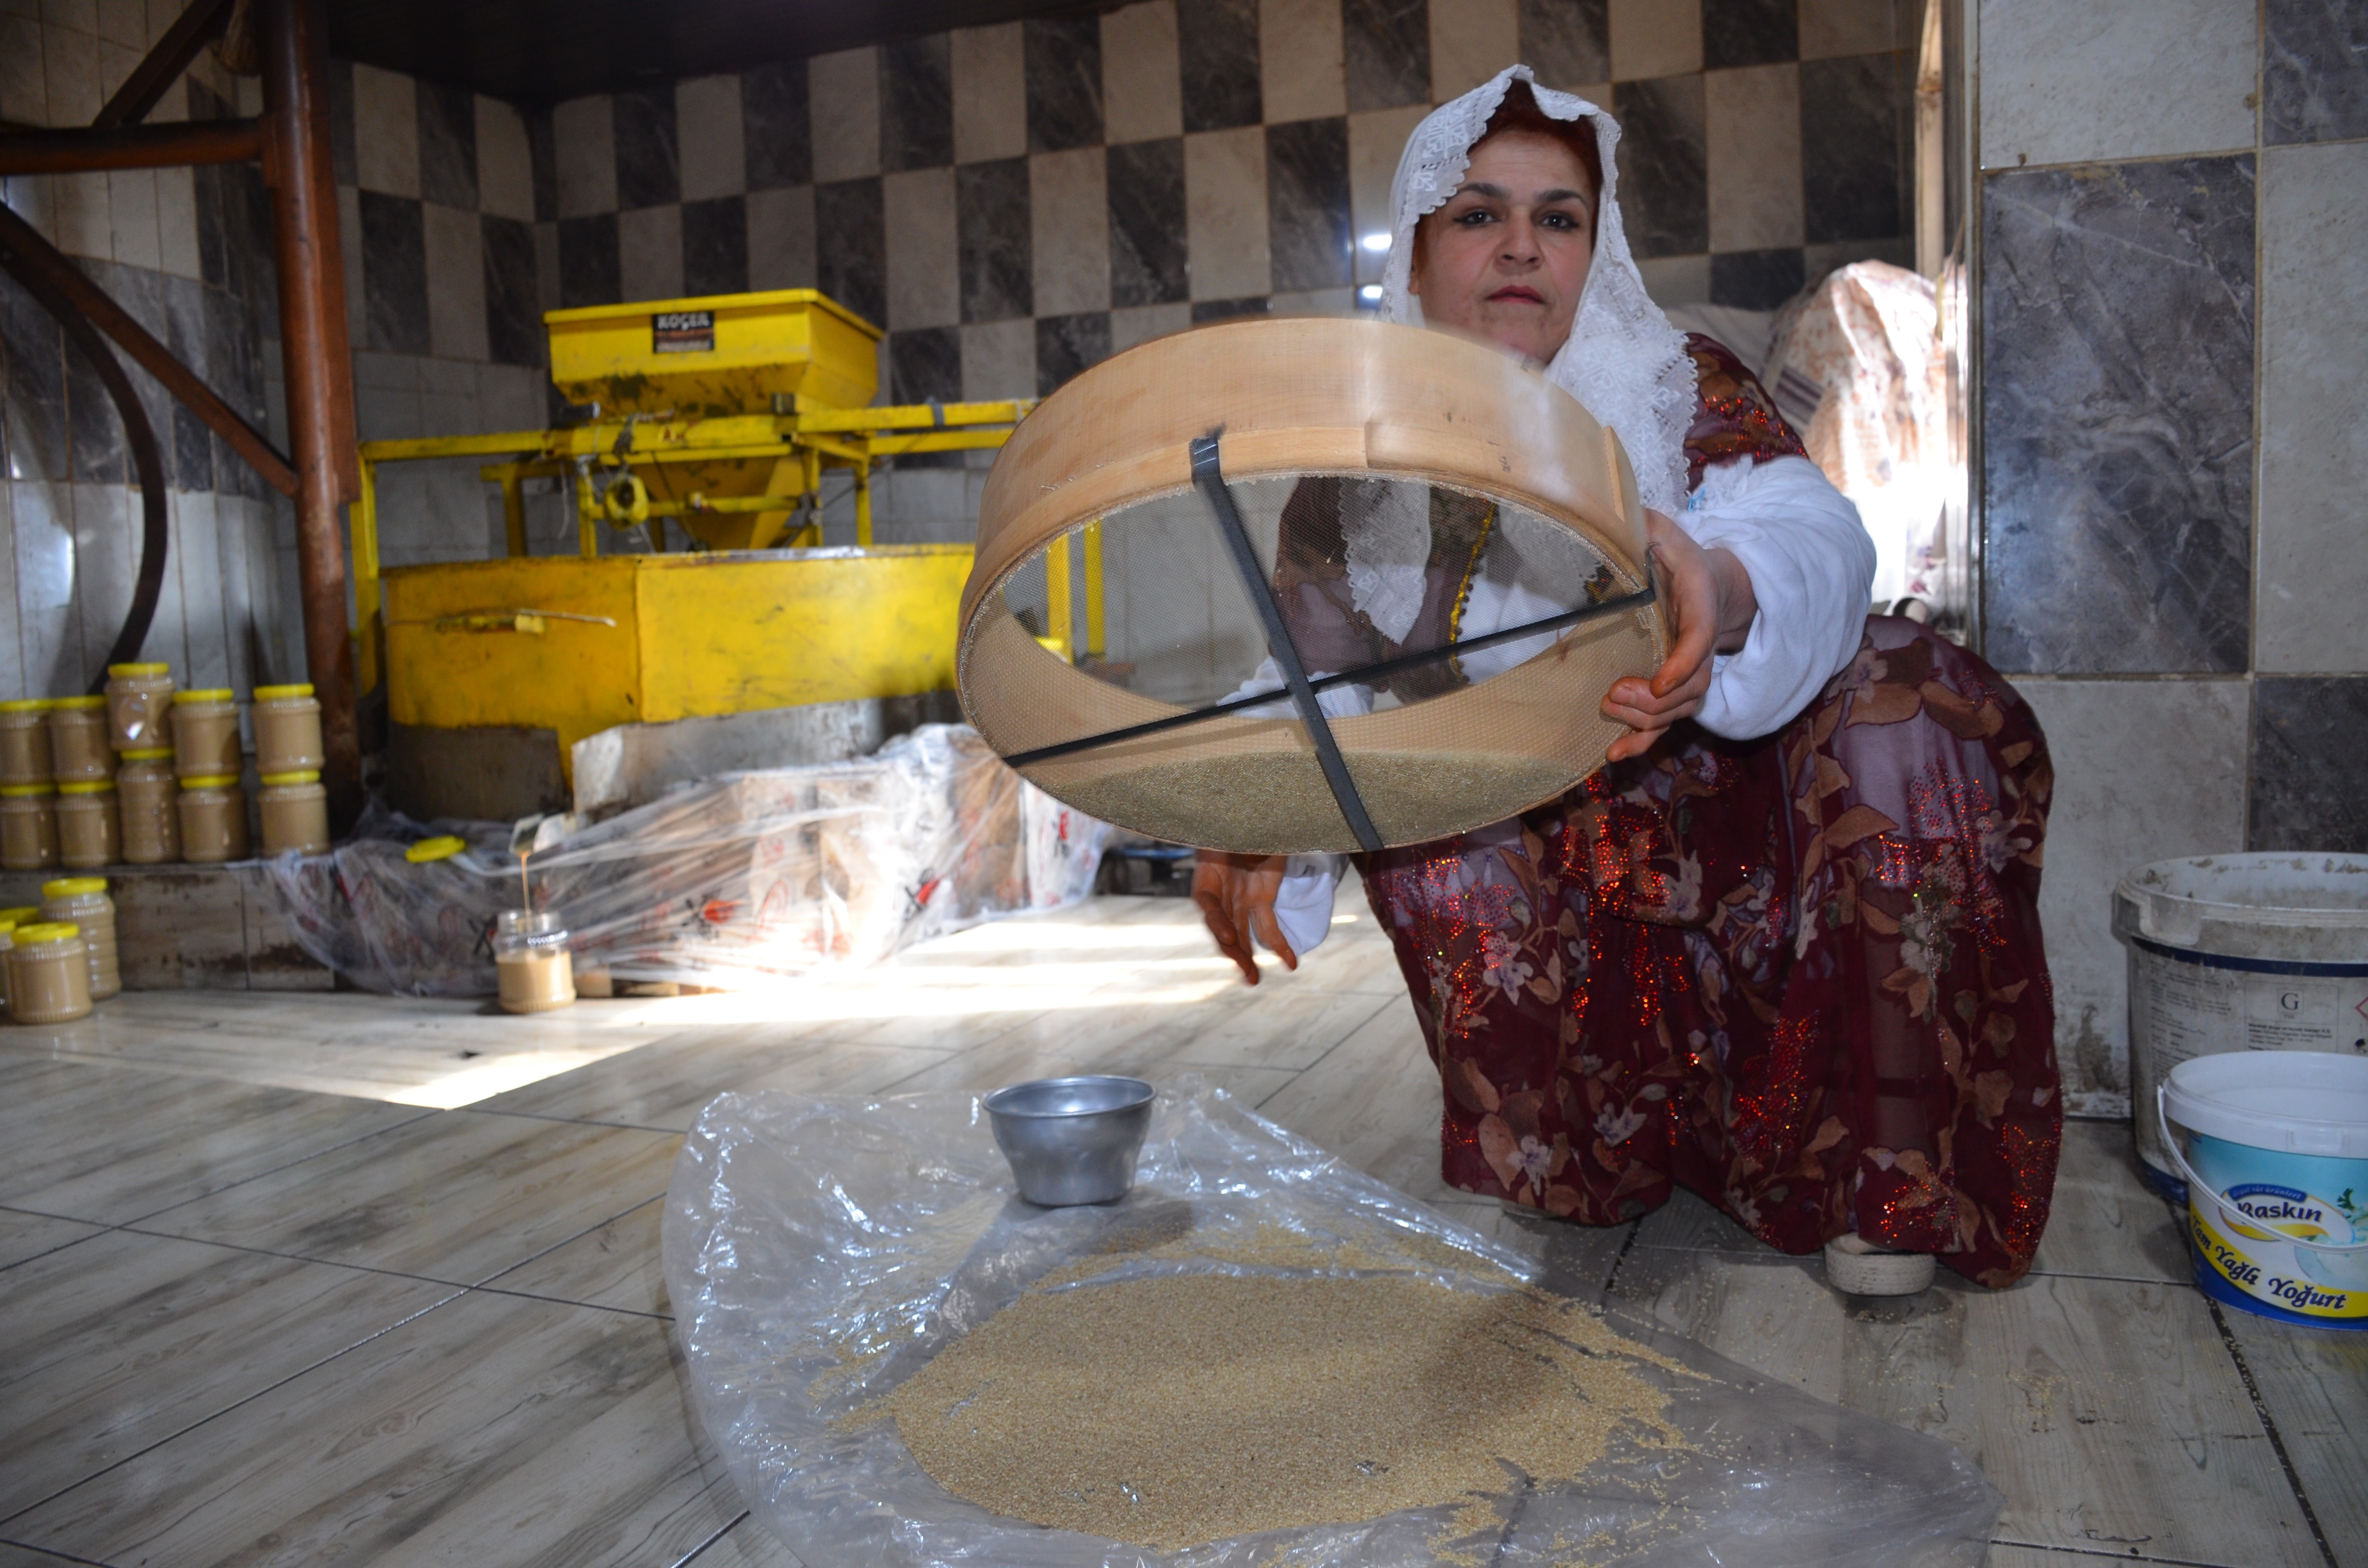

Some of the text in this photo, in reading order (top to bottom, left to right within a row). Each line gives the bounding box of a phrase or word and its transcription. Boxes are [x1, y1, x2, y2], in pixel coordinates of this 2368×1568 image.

[2281, 992, 2299, 1011] G
[2215, 1246, 2260, 1285] Yağlı
[2268, 1278, 2347, 1310] Yoğurt
